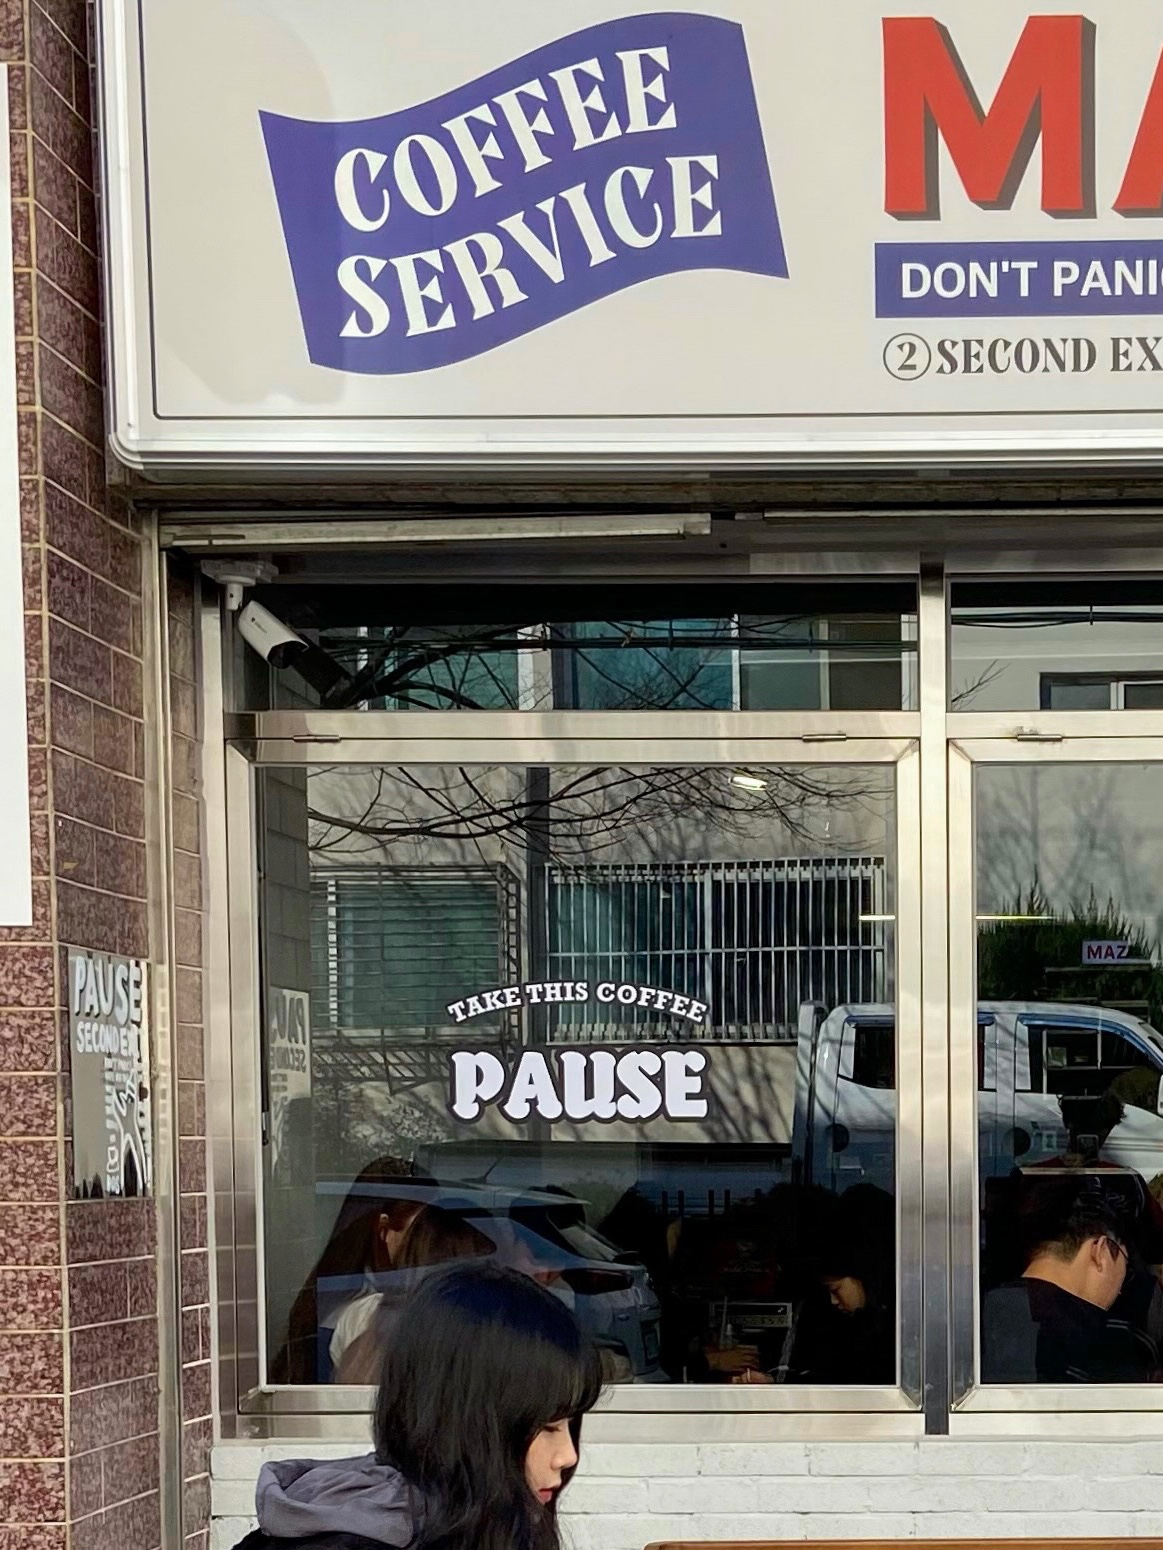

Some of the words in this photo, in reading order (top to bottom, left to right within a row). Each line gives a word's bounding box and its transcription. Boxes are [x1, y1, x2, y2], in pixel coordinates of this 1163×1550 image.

[333, 44, 678, 233] COFFEE
[337, 154, 723, 338] SERVICE
[900, 259, 1038, 300] DON'T
[74, 955, 142, 1027] PAUSE
[446, 985, 523, 1023] TAKE
[525, 981, 589, 1006] THIS
[596, 982, 708, 1023] COFFEE
[450, 1050, 709, 1120] PAUSE
